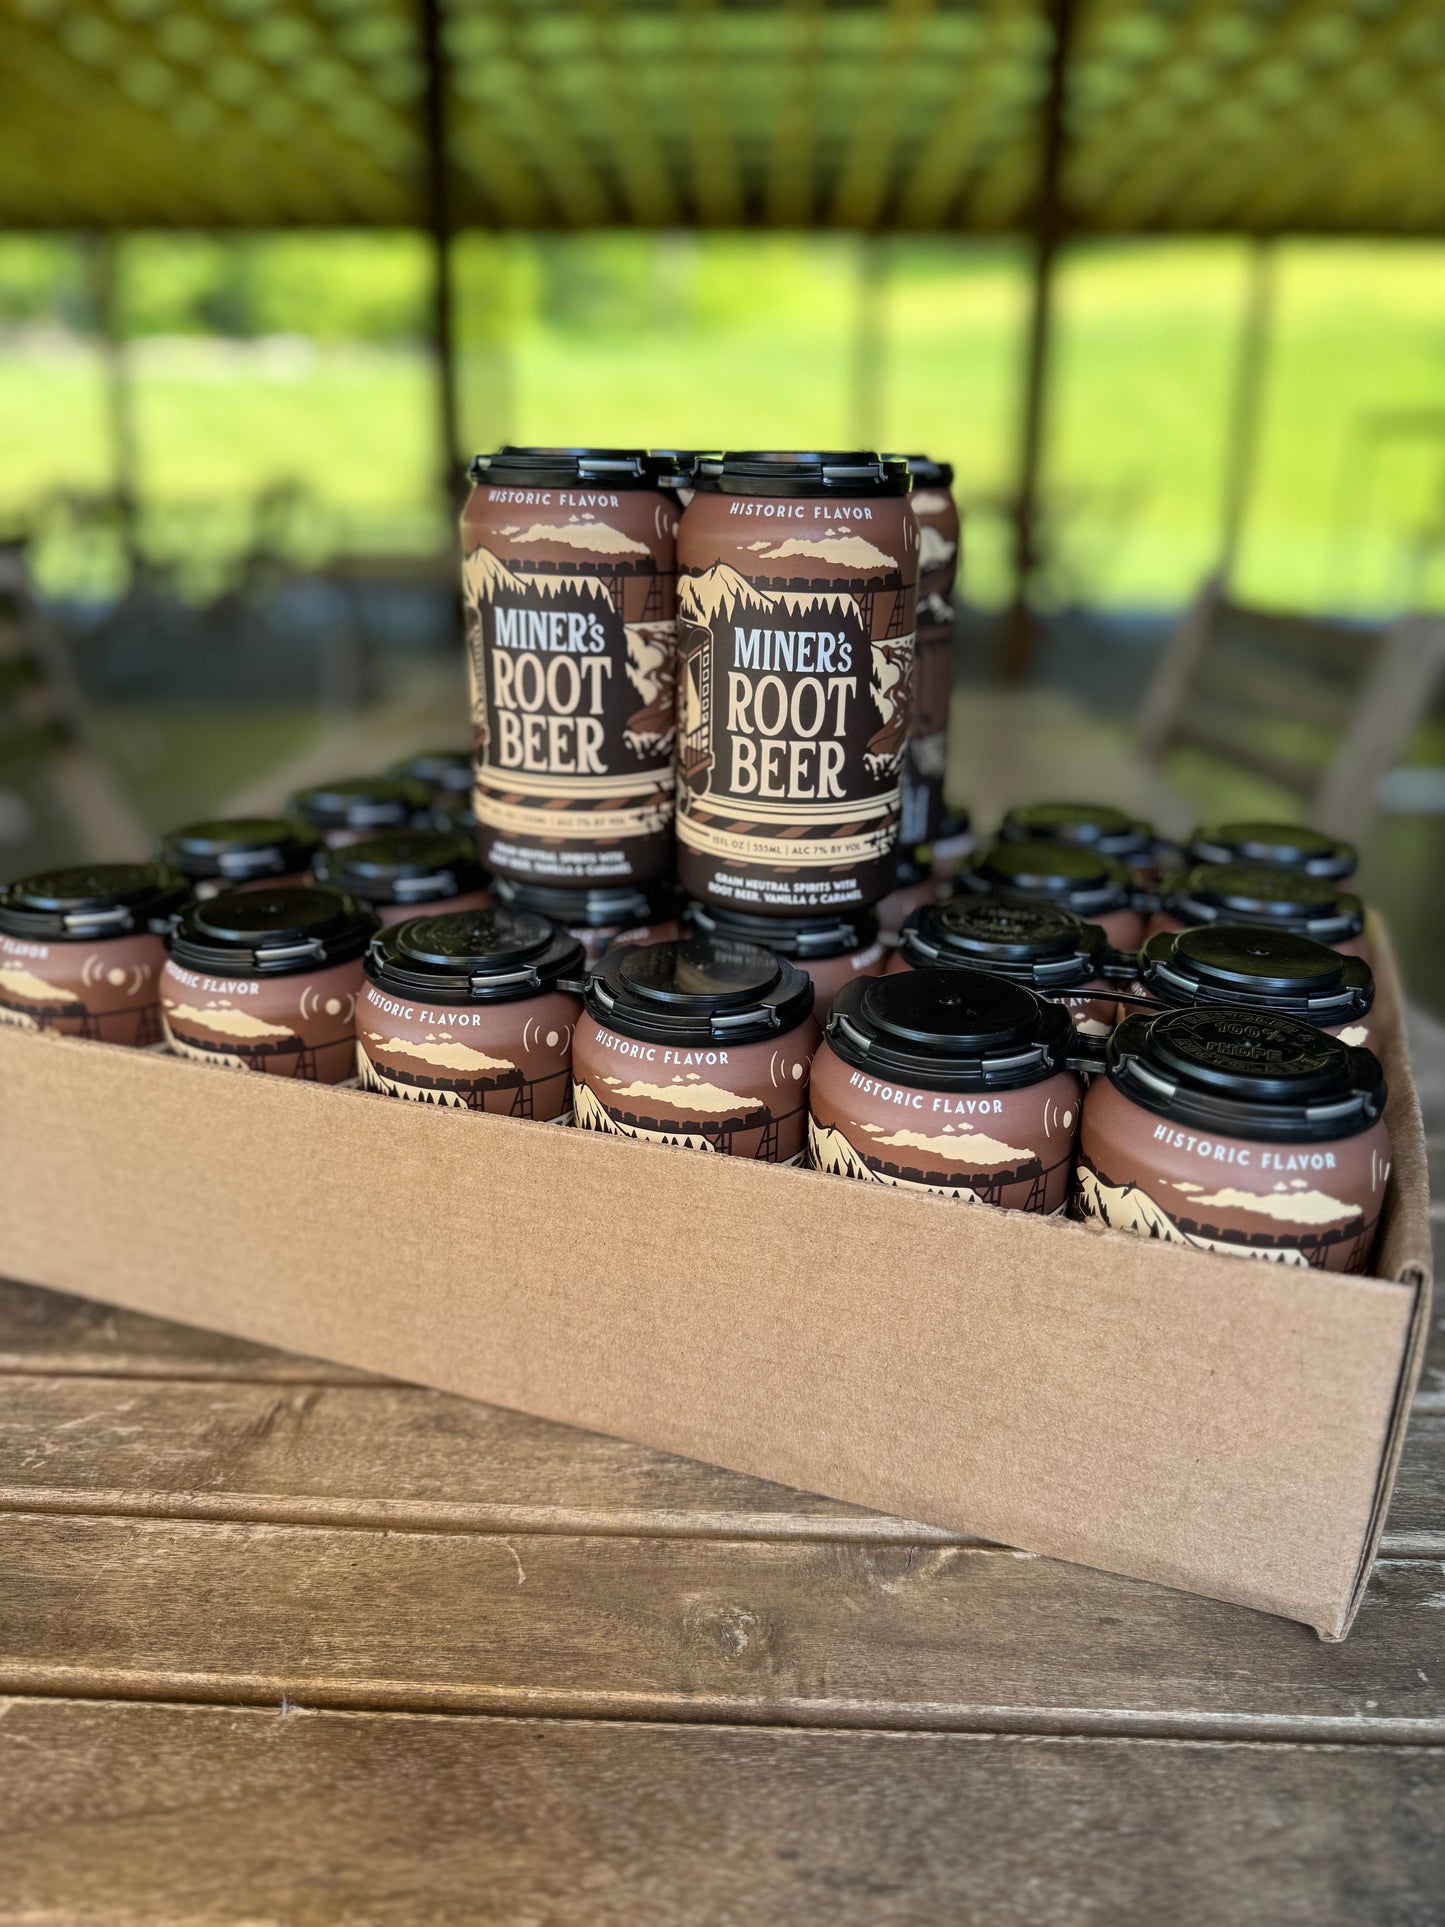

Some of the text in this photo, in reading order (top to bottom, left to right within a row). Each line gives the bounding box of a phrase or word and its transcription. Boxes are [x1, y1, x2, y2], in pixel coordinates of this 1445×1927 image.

[488, 490, 619, 508] HISTORIC FLAVOR
[730, 502, 872, 520] HISTORIC FLAVOR
[492, 649, 612, 715] ROOT
[727, 671, 857, 738] ROOT
[498, 709, 608, 774] BEER
[730, 735, 847, 798] BEER
[791, 845, 811, 855] ALC
[831, 845, 842, 854] BY
[844, 843, 861, 852] VOL
[708, 881, 733, 897] ROOT
[764, 893, 807, 905] VANILLA
[808, 894, 818, 905] &
[820, 889, 863, 904] CARAMEL
[715, 872, 857, 893] GRAIN NEUTRAL SPIRITS WITH
[202, 979, 259, 994] FLAVOR
[367, 989, 481, 1026] HISTORIC FLAVOR
[595, 1029, 729, 1065] HISTORIC FLAVOR
[850, 1072, 1002, 1114] HISTORIC FLAVOR
[1153, 1125, 1336, 1171] HISTORIC FLAVOR
